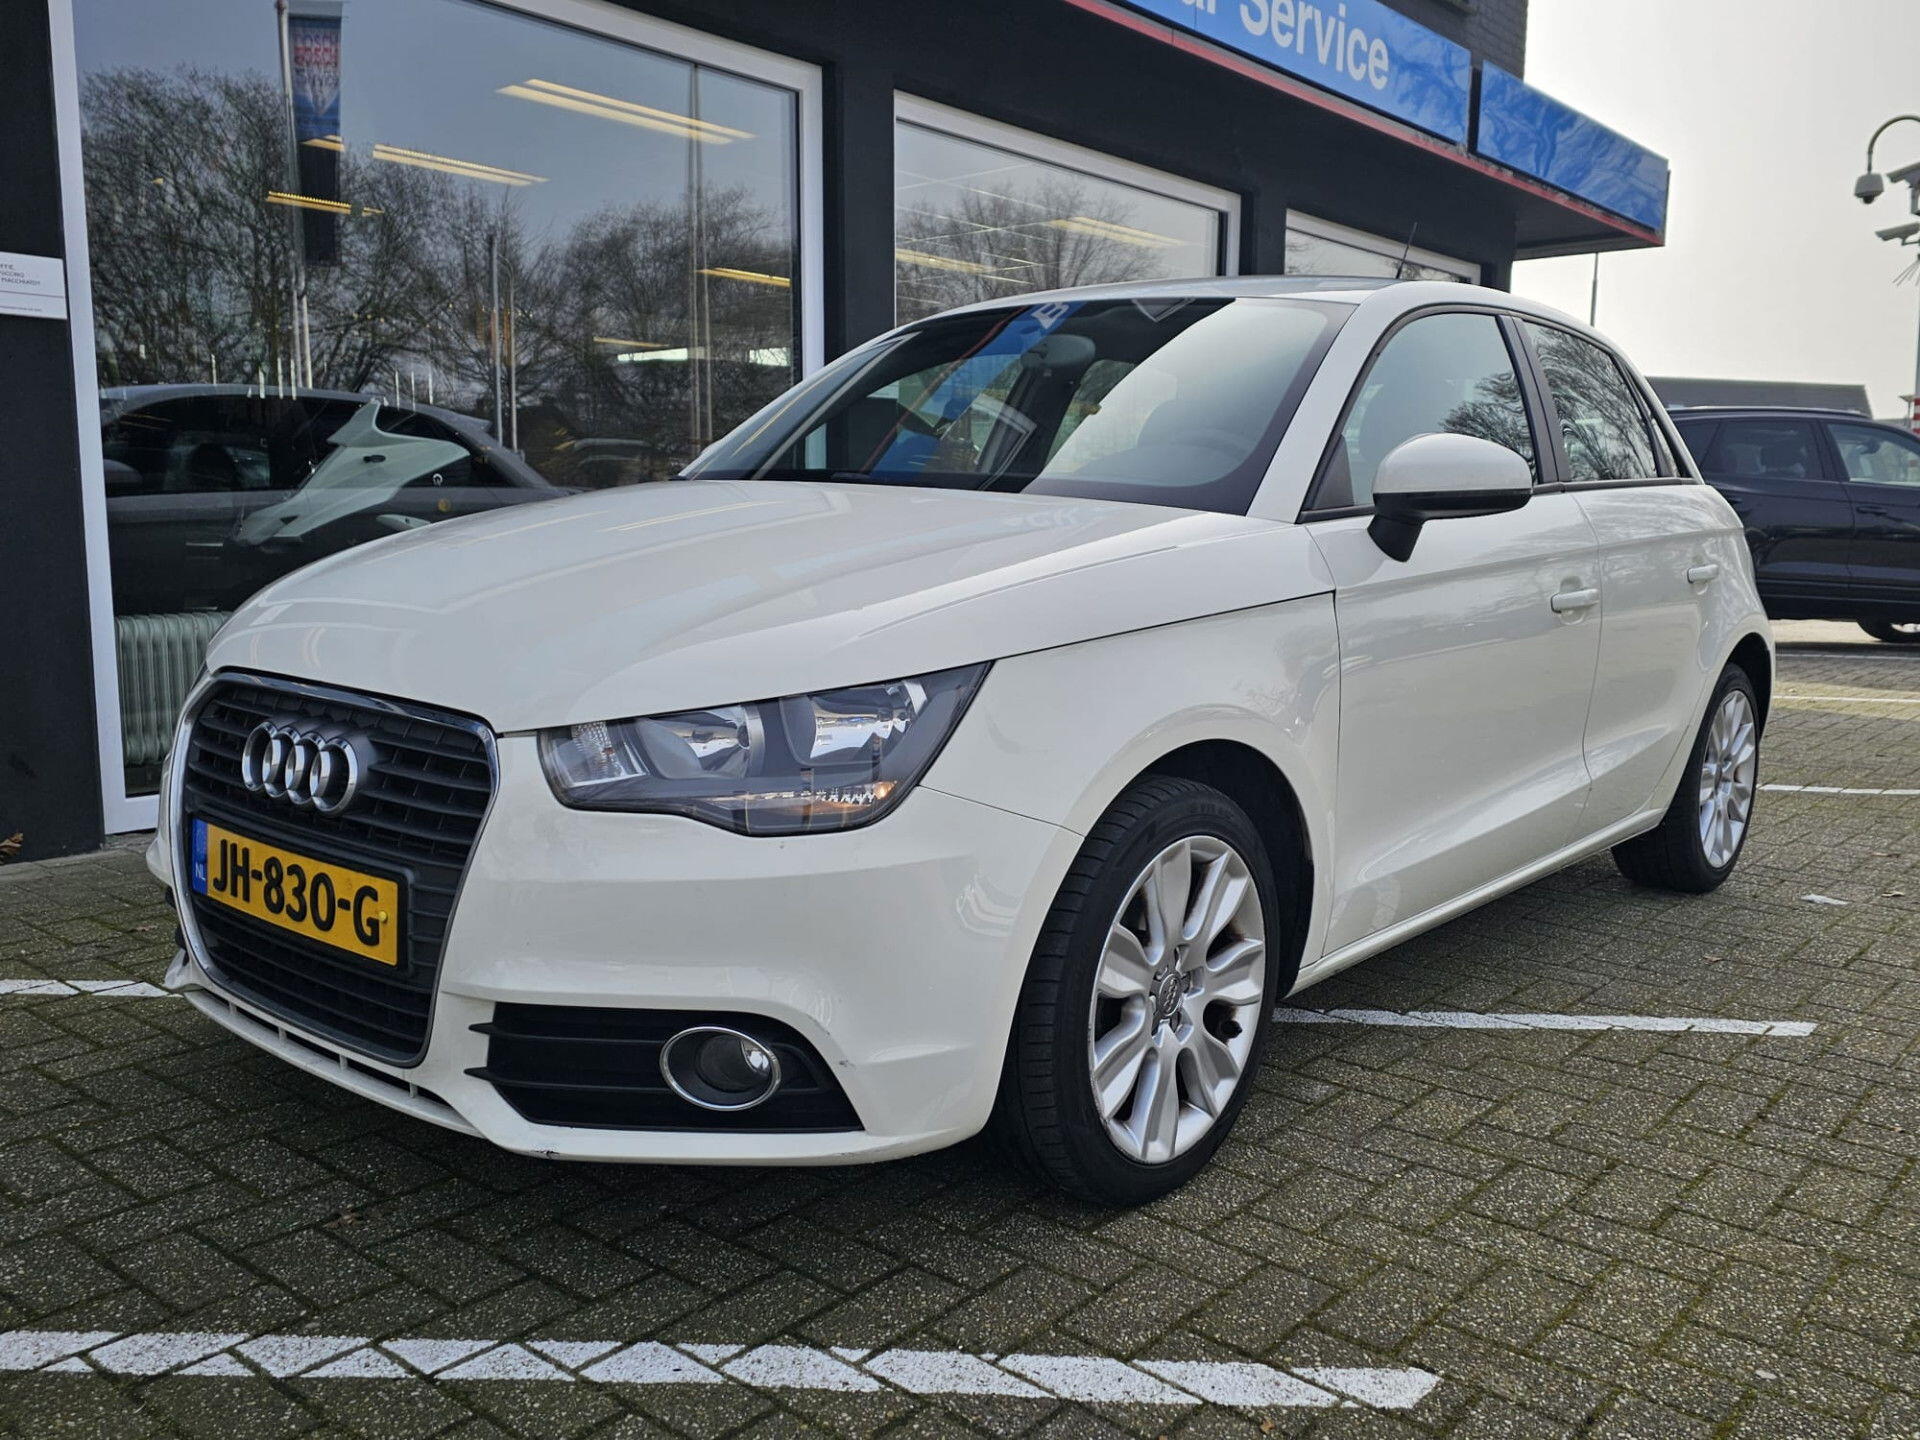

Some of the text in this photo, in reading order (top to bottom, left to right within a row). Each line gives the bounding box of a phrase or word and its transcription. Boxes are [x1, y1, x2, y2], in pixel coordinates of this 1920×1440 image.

[1239, 0, 1390, 91] Service
[195, 863, 206, 882] NL
[213, 838, 380, 946] JH-830-G
